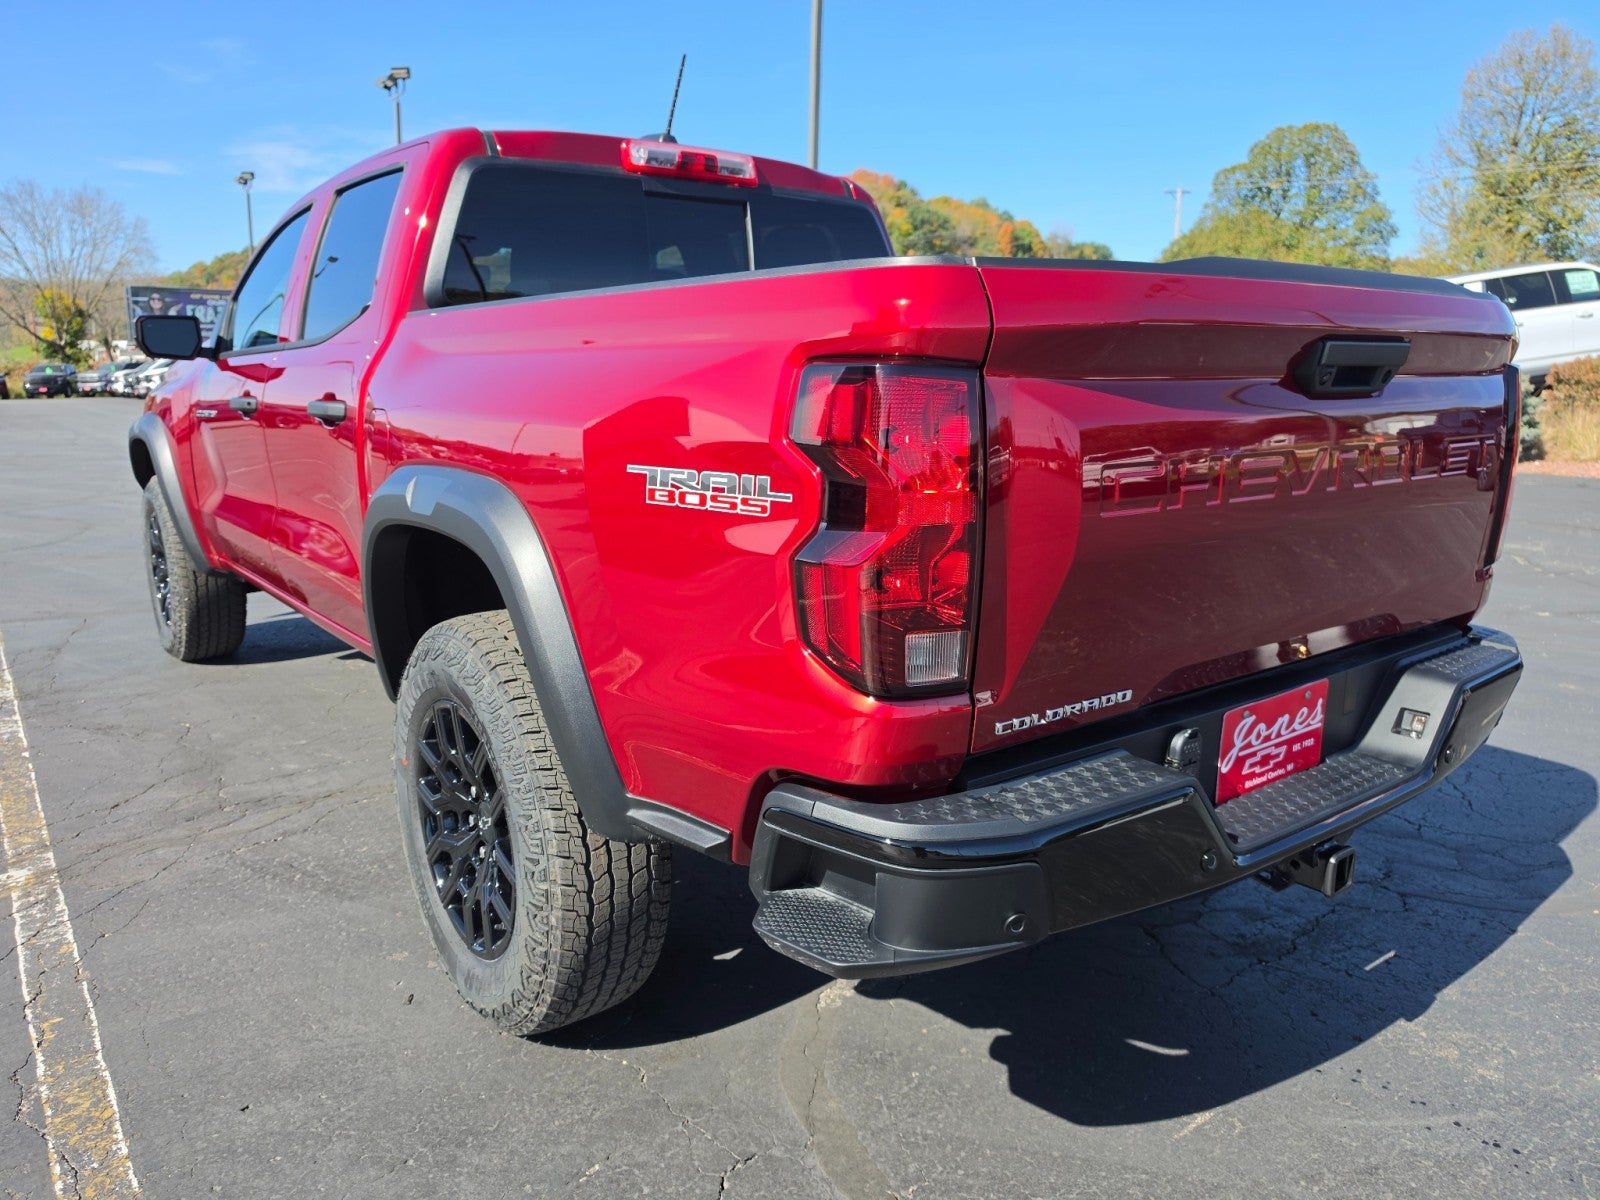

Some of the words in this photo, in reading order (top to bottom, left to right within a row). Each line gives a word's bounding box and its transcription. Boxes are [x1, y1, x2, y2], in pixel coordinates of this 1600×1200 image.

[626, 464, 793, 503] TRAIL
[1099, 433, 1496, 517] CHEVROLET
[645, 488, 771, 517] BOSS
[994, 689, 1133, 736] COLORADO
[1220, 697, 1323, 774] Jones
